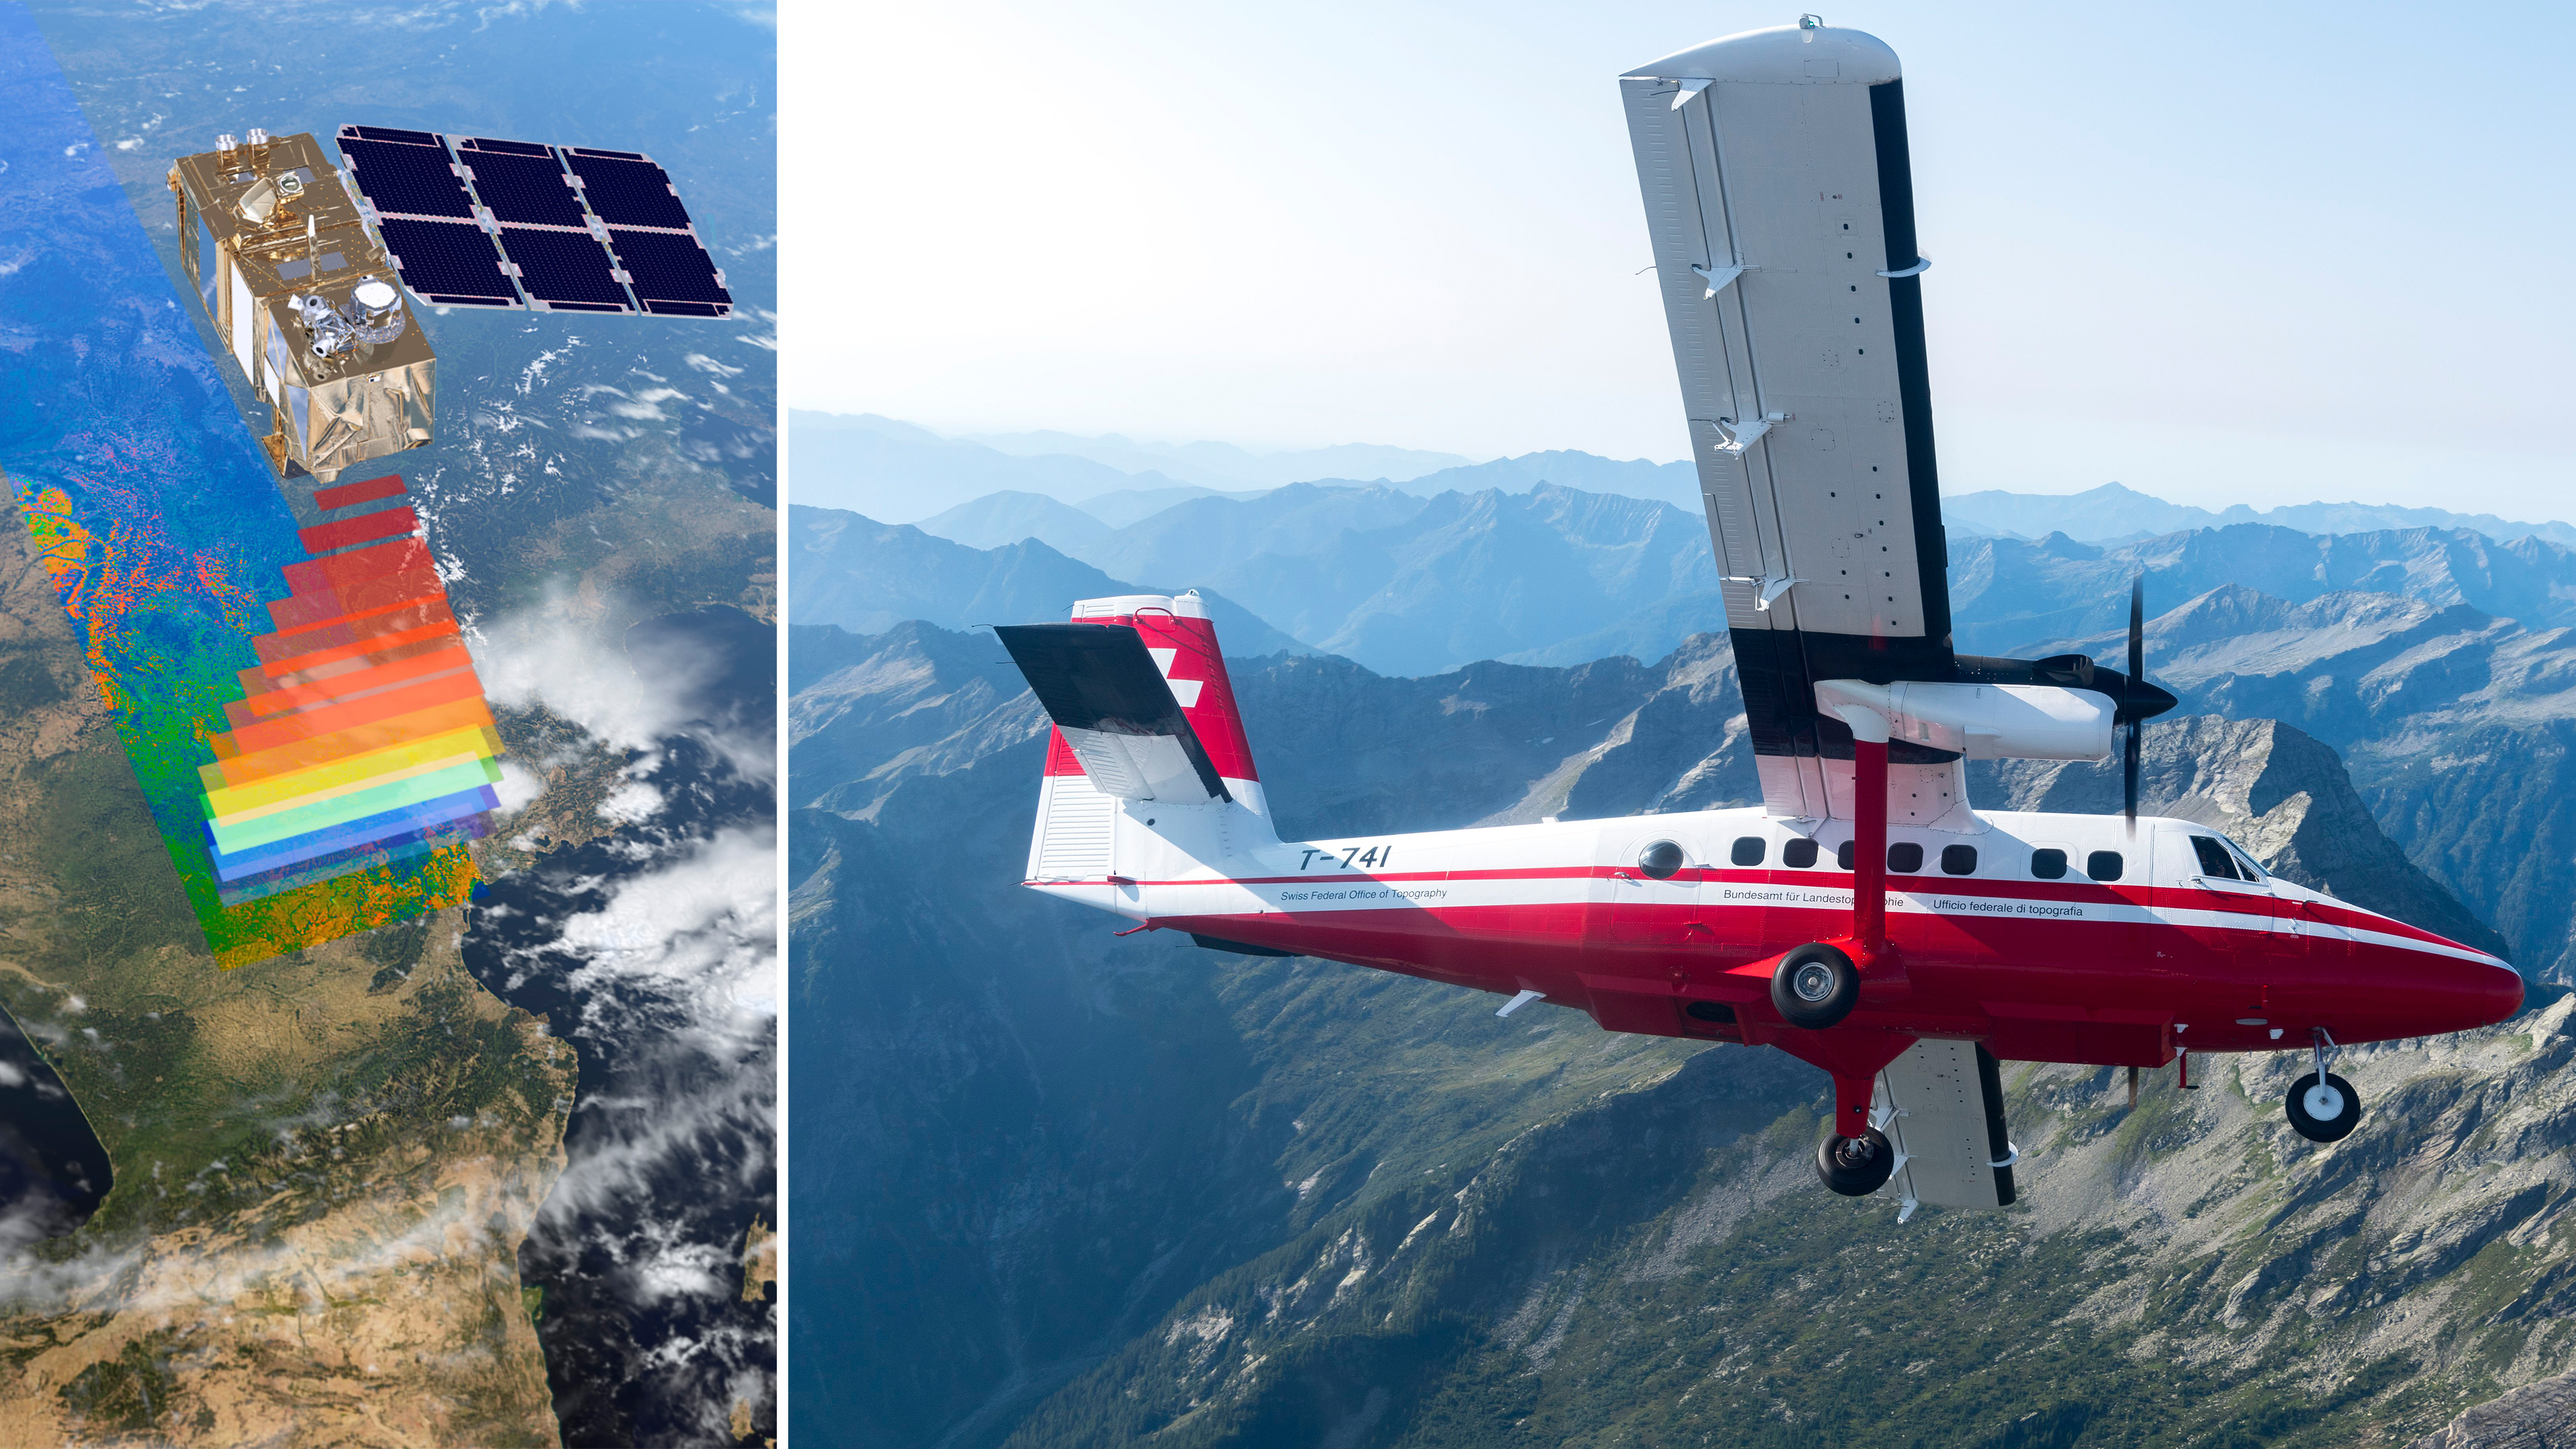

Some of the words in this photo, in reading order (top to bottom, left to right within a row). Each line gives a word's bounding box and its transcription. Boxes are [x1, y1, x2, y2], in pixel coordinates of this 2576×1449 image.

[1300, 845, 1392, 870] T-741
[1281, 891, 1308, 900] Swiss
[1311, 890, 1346, 900] Federal
[1348, 890, 1377, 899] Office
[1379, 890, 1389, 898] of
[1391, 888, 1447, 900] Topography
[1724, 890, 1782, 901] Bundesamt
[1786, 892, 1800, 902] für
[1803, 893, 1904, 906] Landestophie
[1933, 899, 1966, 910] Ufficio
[1970, 901, 2013, 912] federale
[2017, 904, 2026, 913] di
[2029, 905, 2083, 917] topografia
